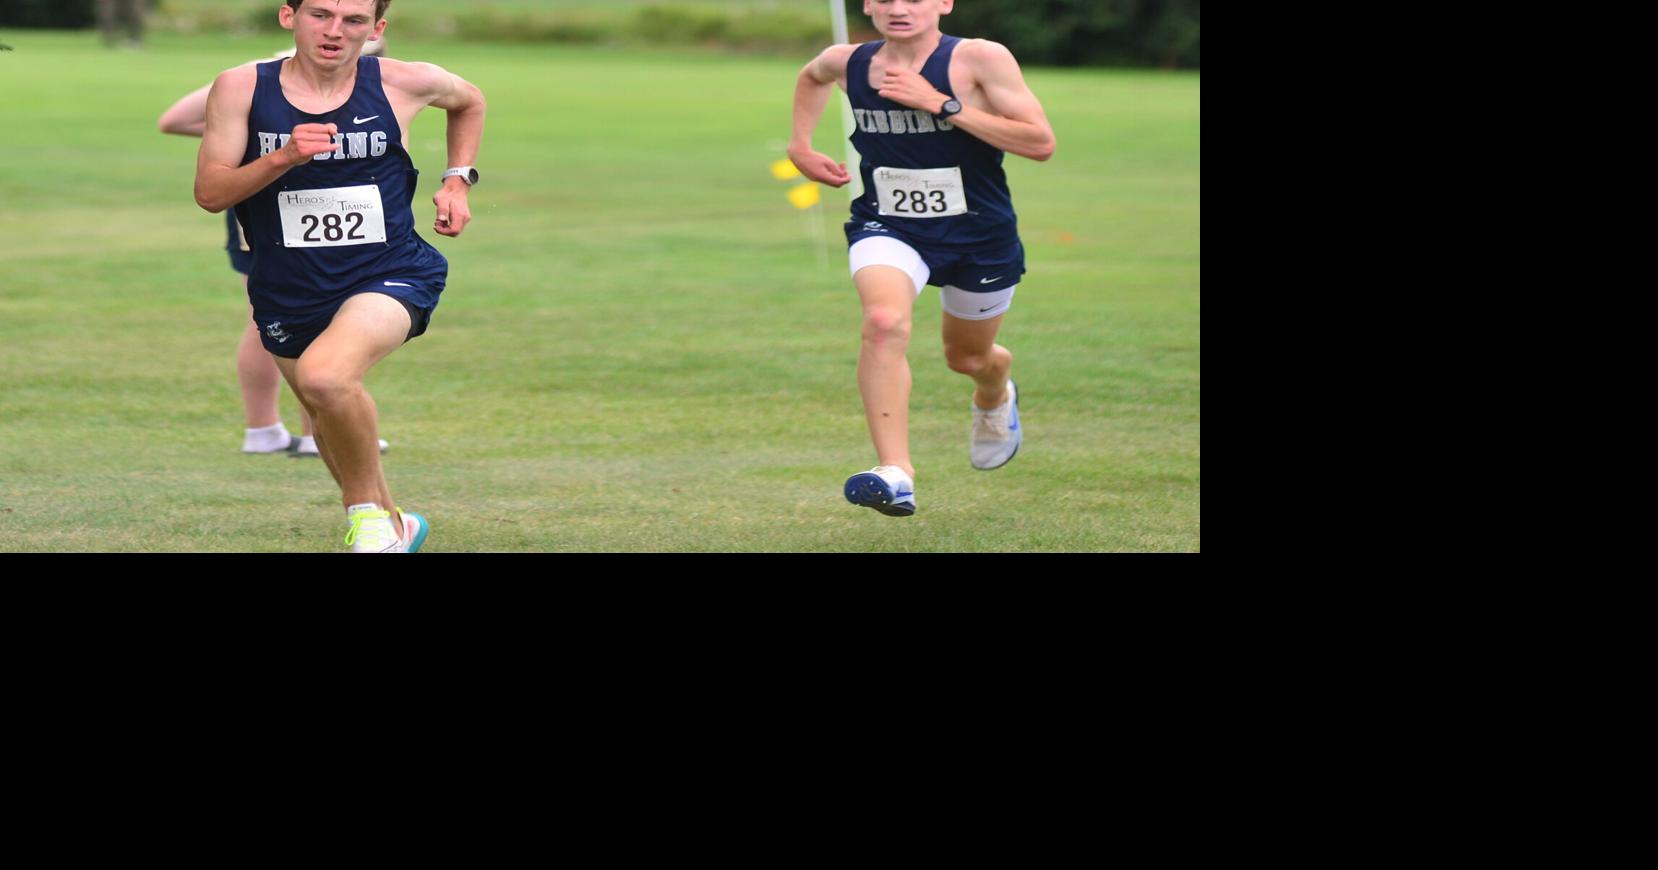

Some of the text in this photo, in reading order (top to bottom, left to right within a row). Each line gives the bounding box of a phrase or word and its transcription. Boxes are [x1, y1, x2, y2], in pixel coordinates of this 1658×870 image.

[258, 131, 387, 160] HIING
[337, 200, 373, 211] TIMING
[892, 189, 947, 214] 283
[301, 212, 365, 242] 282
